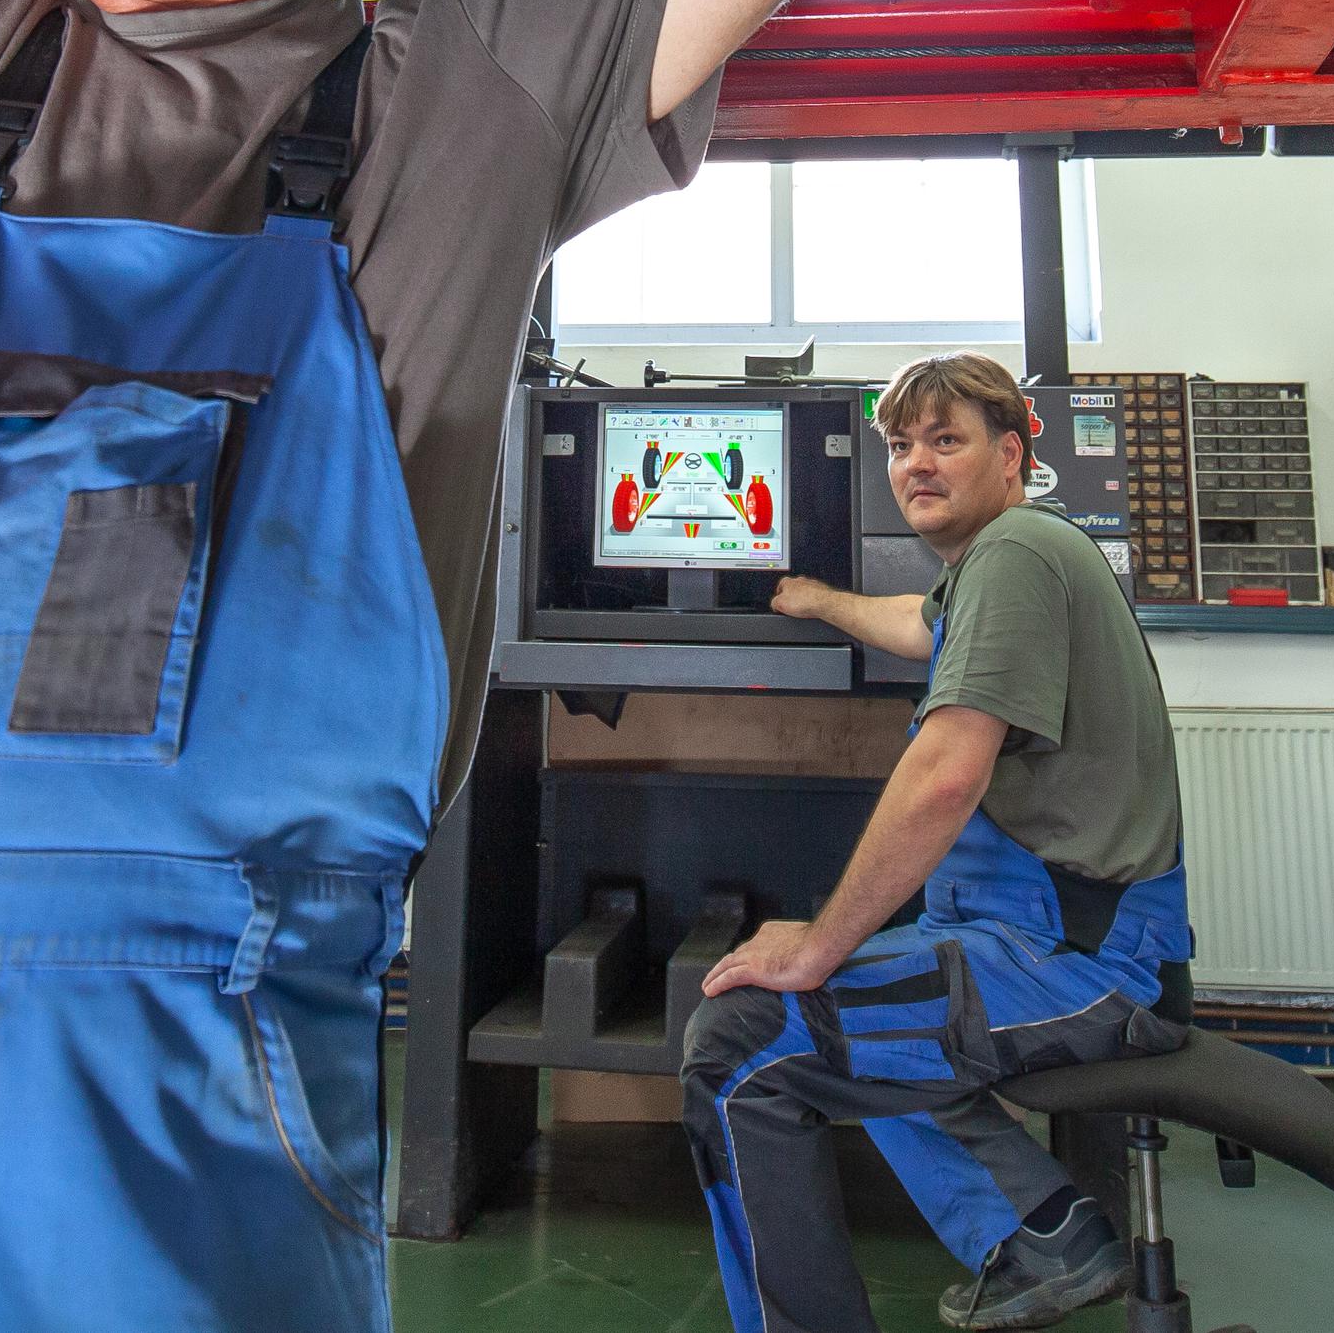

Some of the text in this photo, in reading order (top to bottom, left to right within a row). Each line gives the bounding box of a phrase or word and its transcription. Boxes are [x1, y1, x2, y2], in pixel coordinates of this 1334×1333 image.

[1072, 396, 1113, 405] Mobil 1
[1071, 514, 1120, 527] ODYEAR
